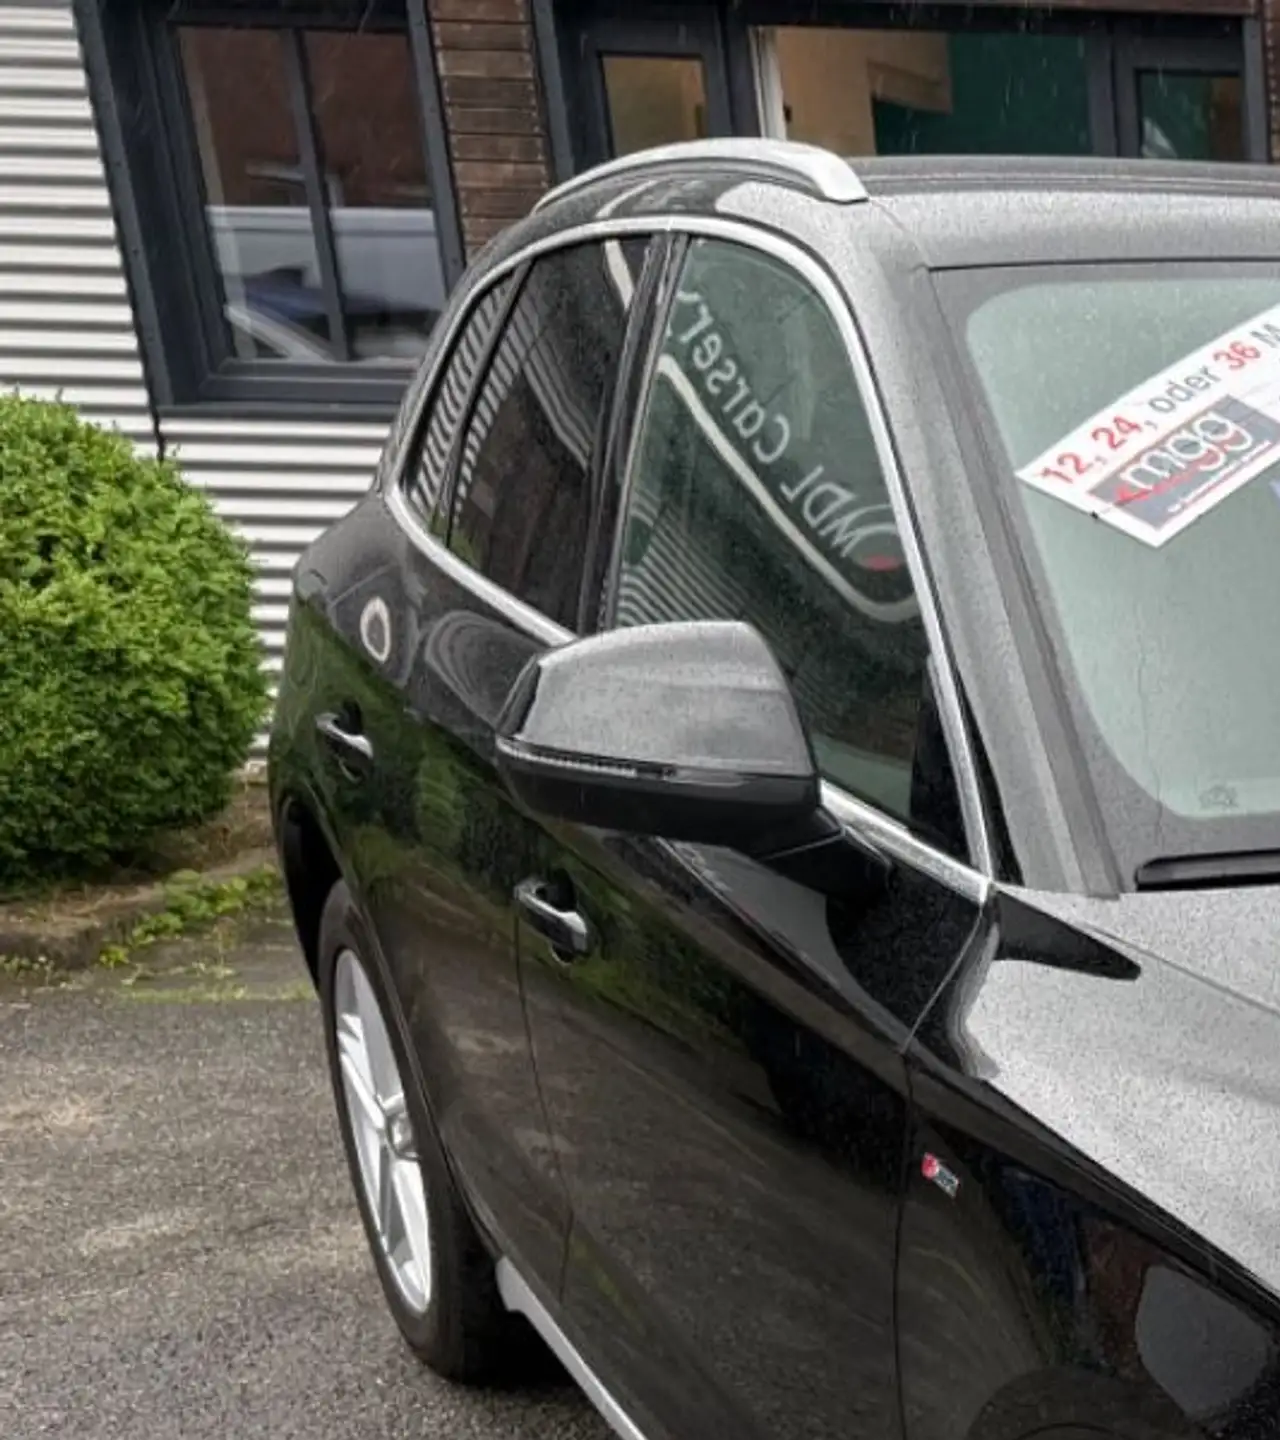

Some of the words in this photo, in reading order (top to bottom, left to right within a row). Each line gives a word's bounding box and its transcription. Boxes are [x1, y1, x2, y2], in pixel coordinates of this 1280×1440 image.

[1040, 452, 1107, 484] 12,
[1091, 415, 1158, 450] 24,
[1148, 365, 1222, 415] oder
[1213, 340, 1261, 370] 36
[1119, 409, 1253, 491] mgg
